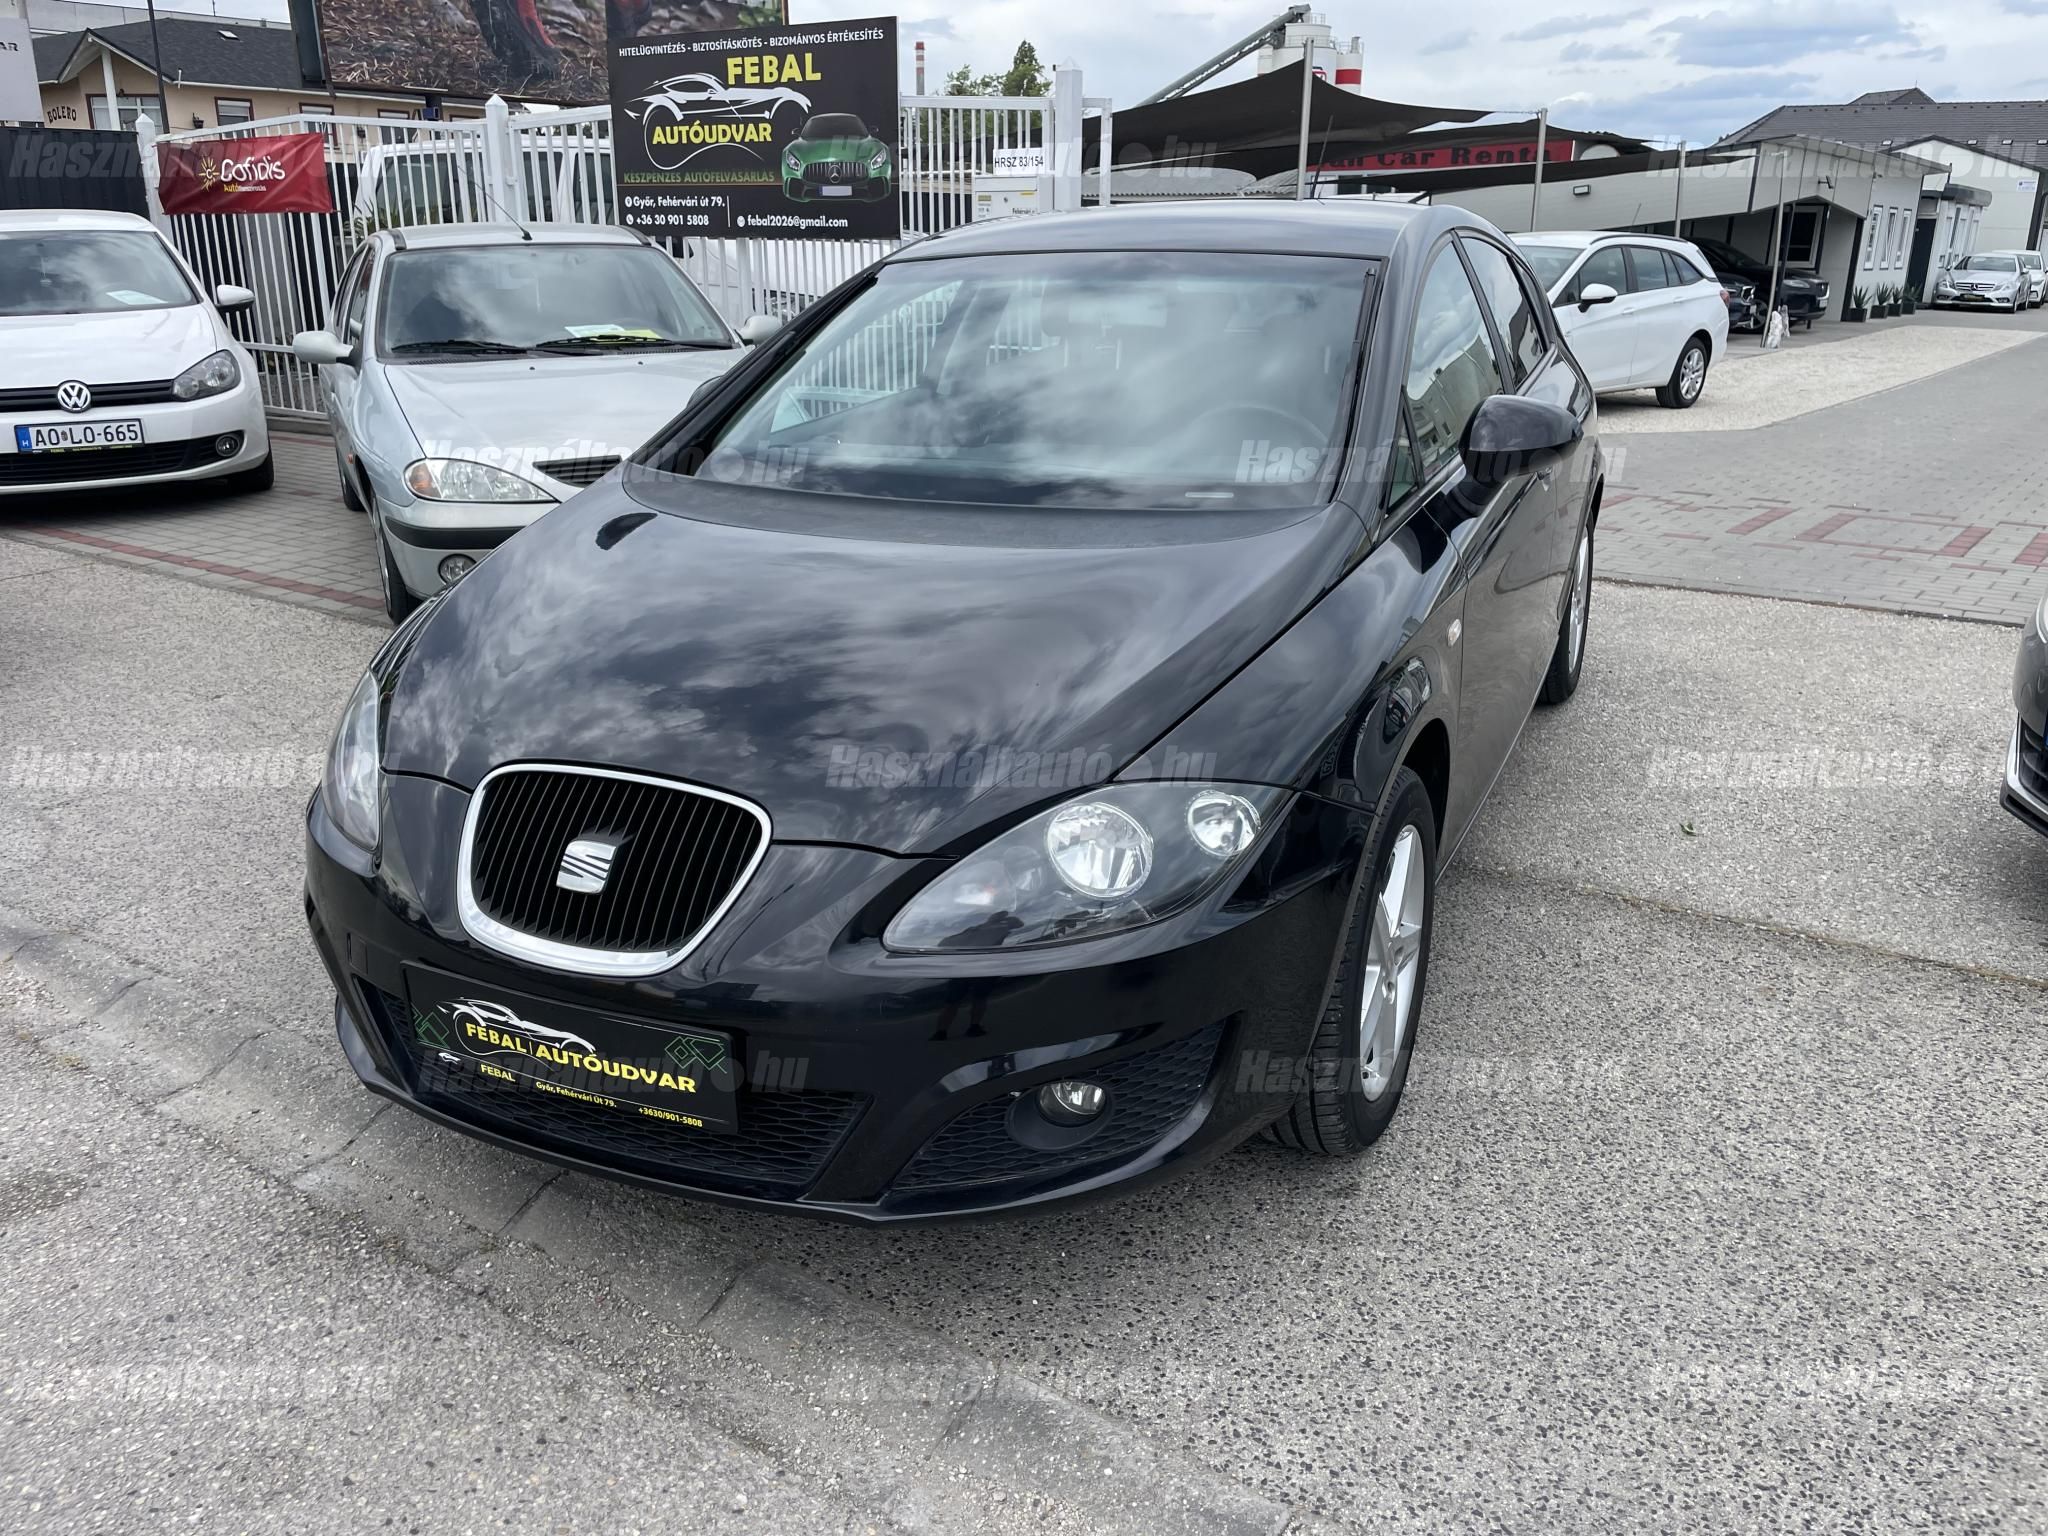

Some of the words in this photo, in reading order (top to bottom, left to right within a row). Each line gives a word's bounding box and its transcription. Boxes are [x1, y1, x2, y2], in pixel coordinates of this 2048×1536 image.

[619, 44, 686, 57] HITELÜGYINTÉZÉS
[692, 38, 763, 52] BIZTOSÍTÁSKÖTÉS
[769, 33, 826, 47] BIZOMÁNYOS
[827, 29, 884, 43] ÉRTÉKESÍTÉS
[727, 53, 822, 85] FEBAL
[47, 105, 77, 123] BOLERO
[653, 120, 773, 145] AUTÓUDVAR
[221, 155, 286, 182] Cofidis
[994, 157, 1017, 168] HRSZ
[633, 196, 656, 208] Győr,
[658, 195, 698, 207] Fehérvári
[700, 196, 709, 207] út
[711, 196, 725, 207] 79.
[636, 215, 652, 225] +36
[654, 215, 666, 225] 30
[668, 215, 684, 225] 901
[686, 214, 709, 226] 5808
[747, 215, 848, 229] febal2026@gmail.com
[465, 1023, 528, 1054] FEBAL
[536, 1045, 697, 1093] AUTÓUDVAR
[480, 1064, 516, 1082] FEBAL
[535, 1081, 556, 1094] Győr,
[556, 1086, 593, 1103] Fehérvári
[603, 1097, 617, 1108] 79.
[638, 1106, 703, 1128] +3630/901-5808
